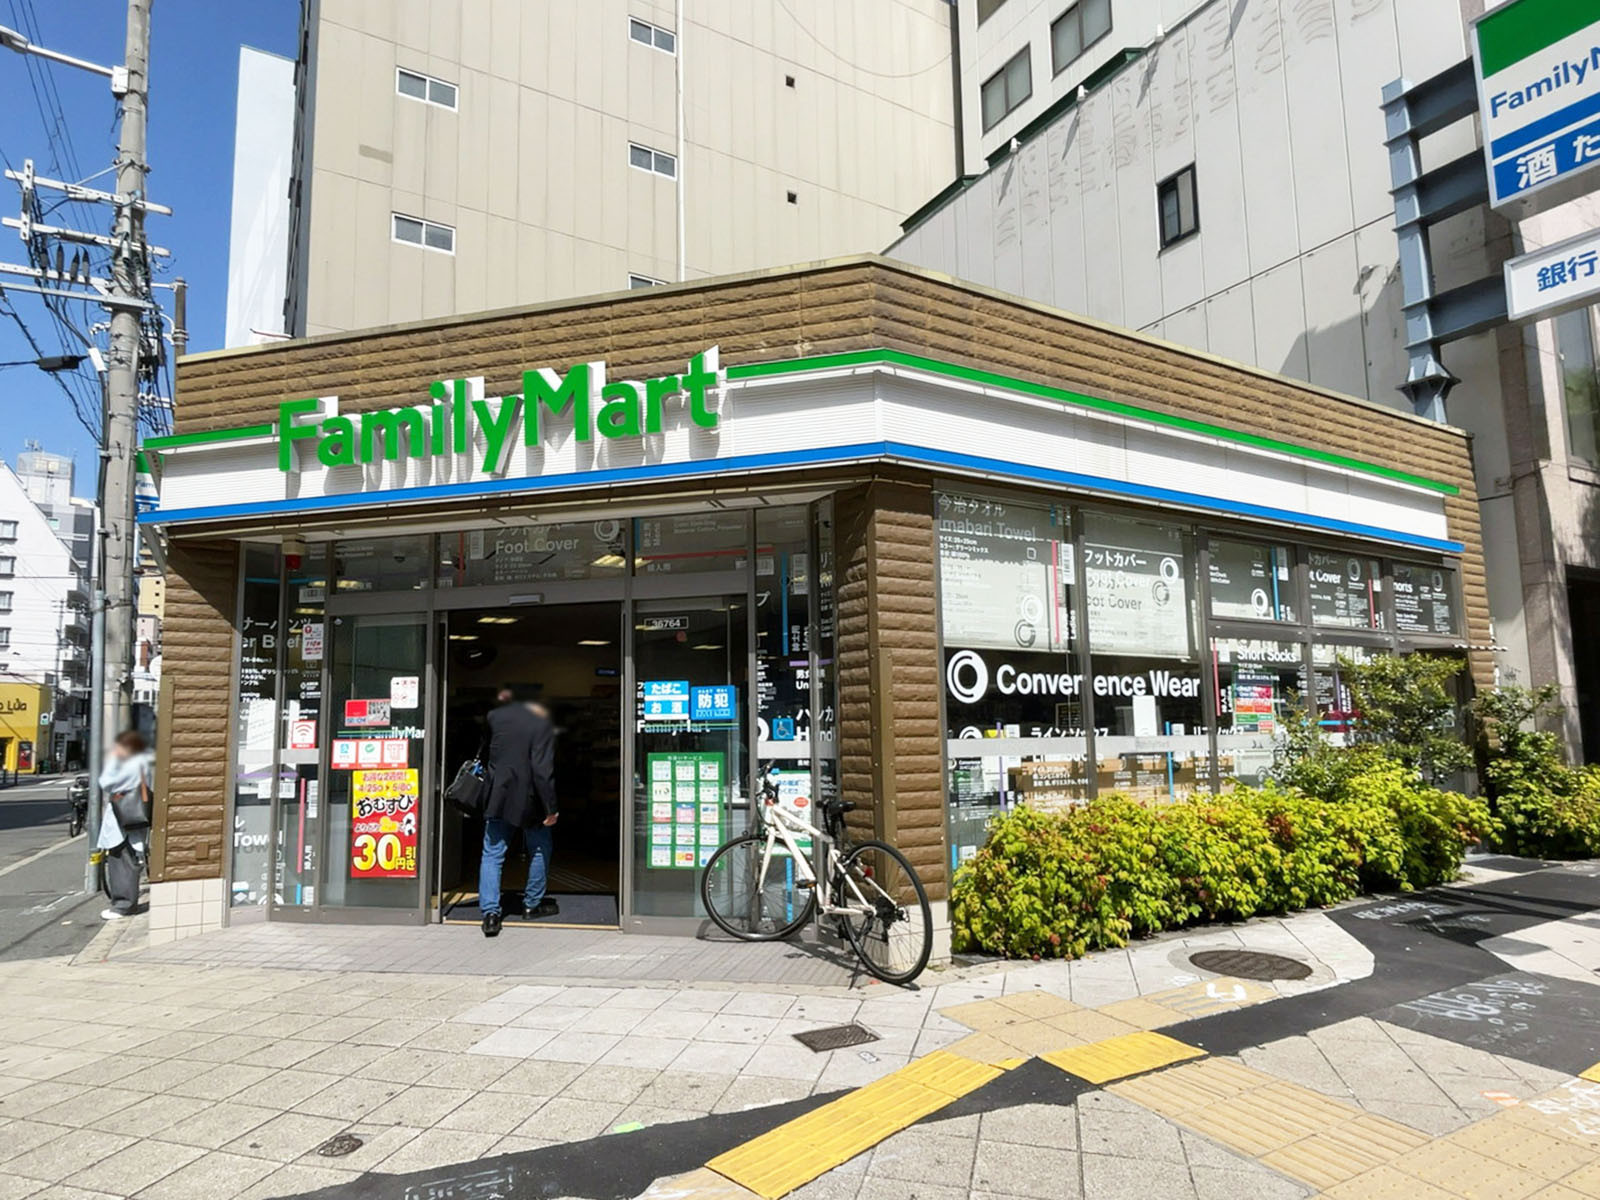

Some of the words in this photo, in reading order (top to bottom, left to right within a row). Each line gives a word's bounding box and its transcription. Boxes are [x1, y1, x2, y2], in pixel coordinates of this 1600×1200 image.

[1516, 143, 1558, 189] 酒
[278, 346, 718, 474] FamilyMart
[938, 493, 1006, 517] 今治タオル
[939, 516, 992, 537] Imabari
[996, 522, 1036, 542] Towel
[496, 540, 530, 554] Foot
[534, 538, 579, 552] Cover
[1084, 549, 1147, 567] フットカバー
[1315, 569, 1342, 584] Cover
[1237, 645, 1266, 661] Short
[1267, 648, 1298, 663] Socks
[651, 683, 682, 694] たばこ
[996, 664, 1147, 697] Conveence
[1148, 670, 1201, 698] Wear
[697, 693, 729, 709] 防犯
[356, 794, 413, 816] おむすび
[234, 830, 283, 847] Towl
